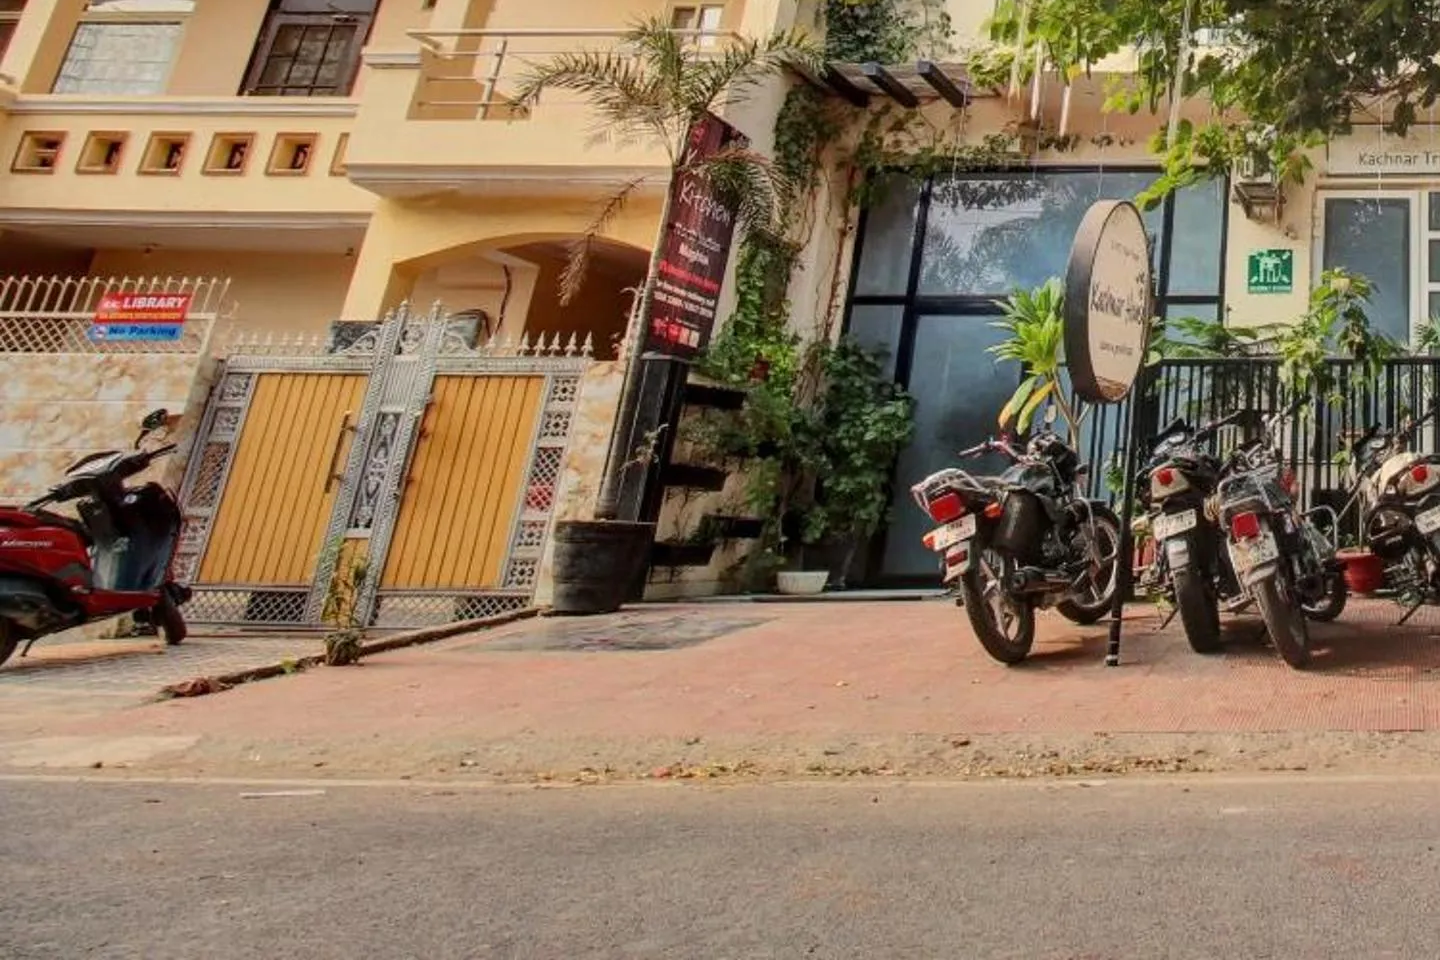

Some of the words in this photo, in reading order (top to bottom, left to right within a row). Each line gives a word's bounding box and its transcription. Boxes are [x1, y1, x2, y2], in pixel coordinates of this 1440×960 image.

[1358, 150, 1420, 166] Kachnar
[122, 296, 188, 309] LIBRARY
[108, 325, 126, 335] No
[128, 325, 178, 337] Parking
